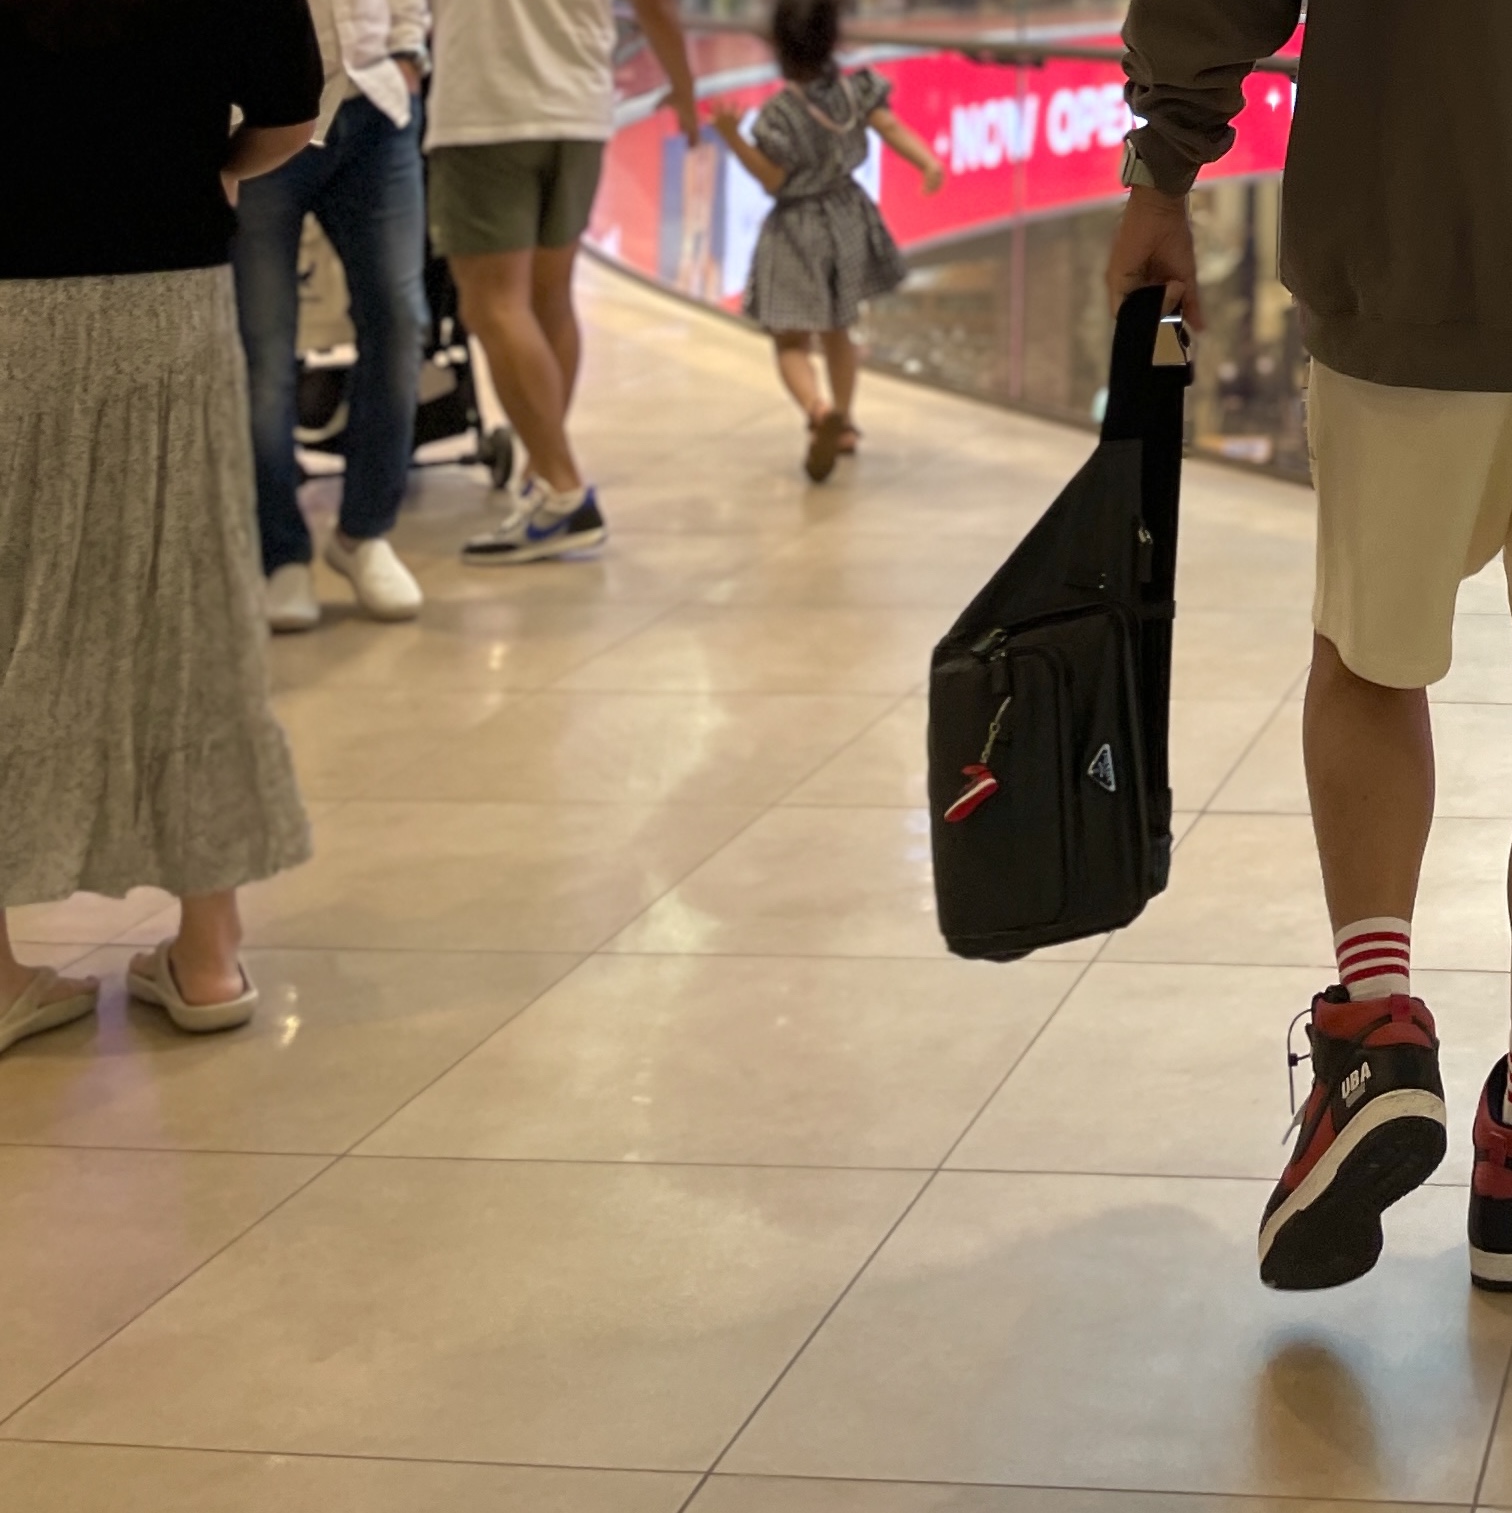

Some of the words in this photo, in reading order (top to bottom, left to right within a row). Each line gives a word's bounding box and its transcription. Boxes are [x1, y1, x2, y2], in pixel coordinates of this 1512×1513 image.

[950, 94, 1040, 174] NOW
[1046, 82, 1147, 155] OPE
[1341, 1061, 1372, 1099] UBA
